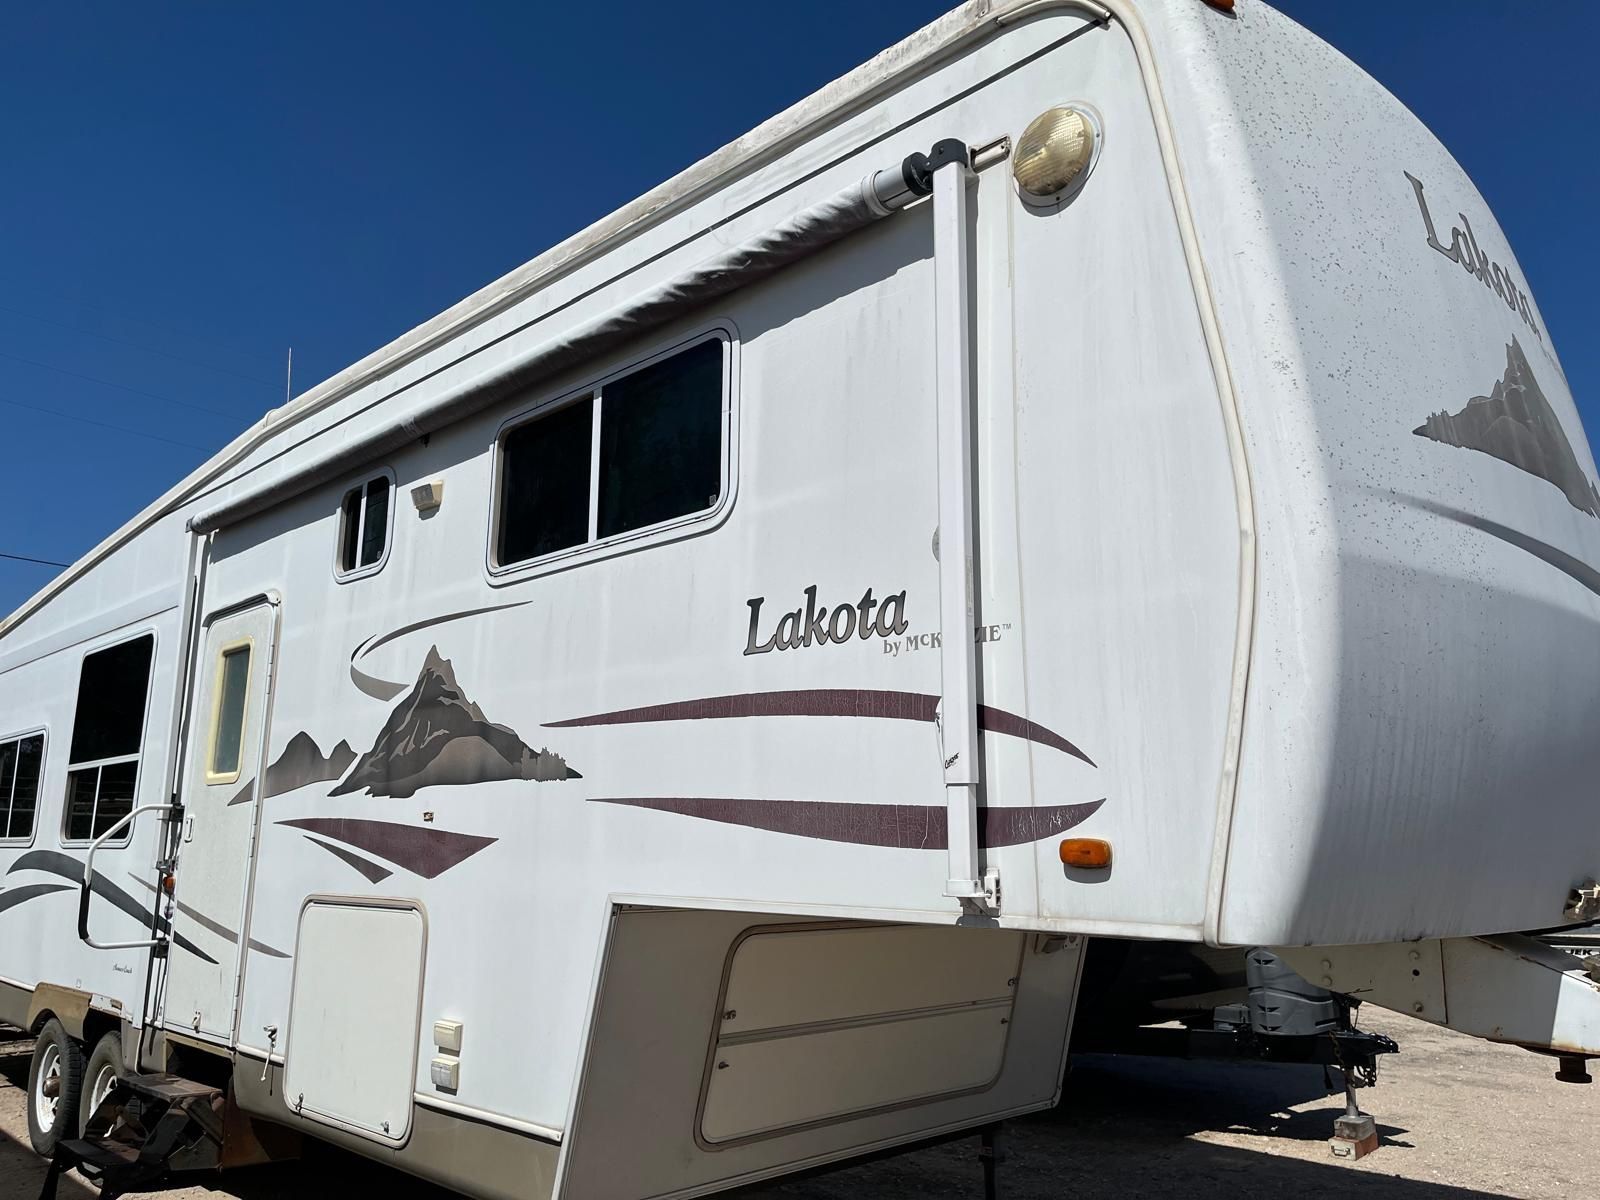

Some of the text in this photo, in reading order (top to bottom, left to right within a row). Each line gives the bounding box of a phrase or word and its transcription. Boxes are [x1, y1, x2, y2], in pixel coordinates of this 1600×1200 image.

[1403, 170, 1542, 342] Lakota
[743, 584, 909, 656] Lakota
[883, 639, 902, 657] by
